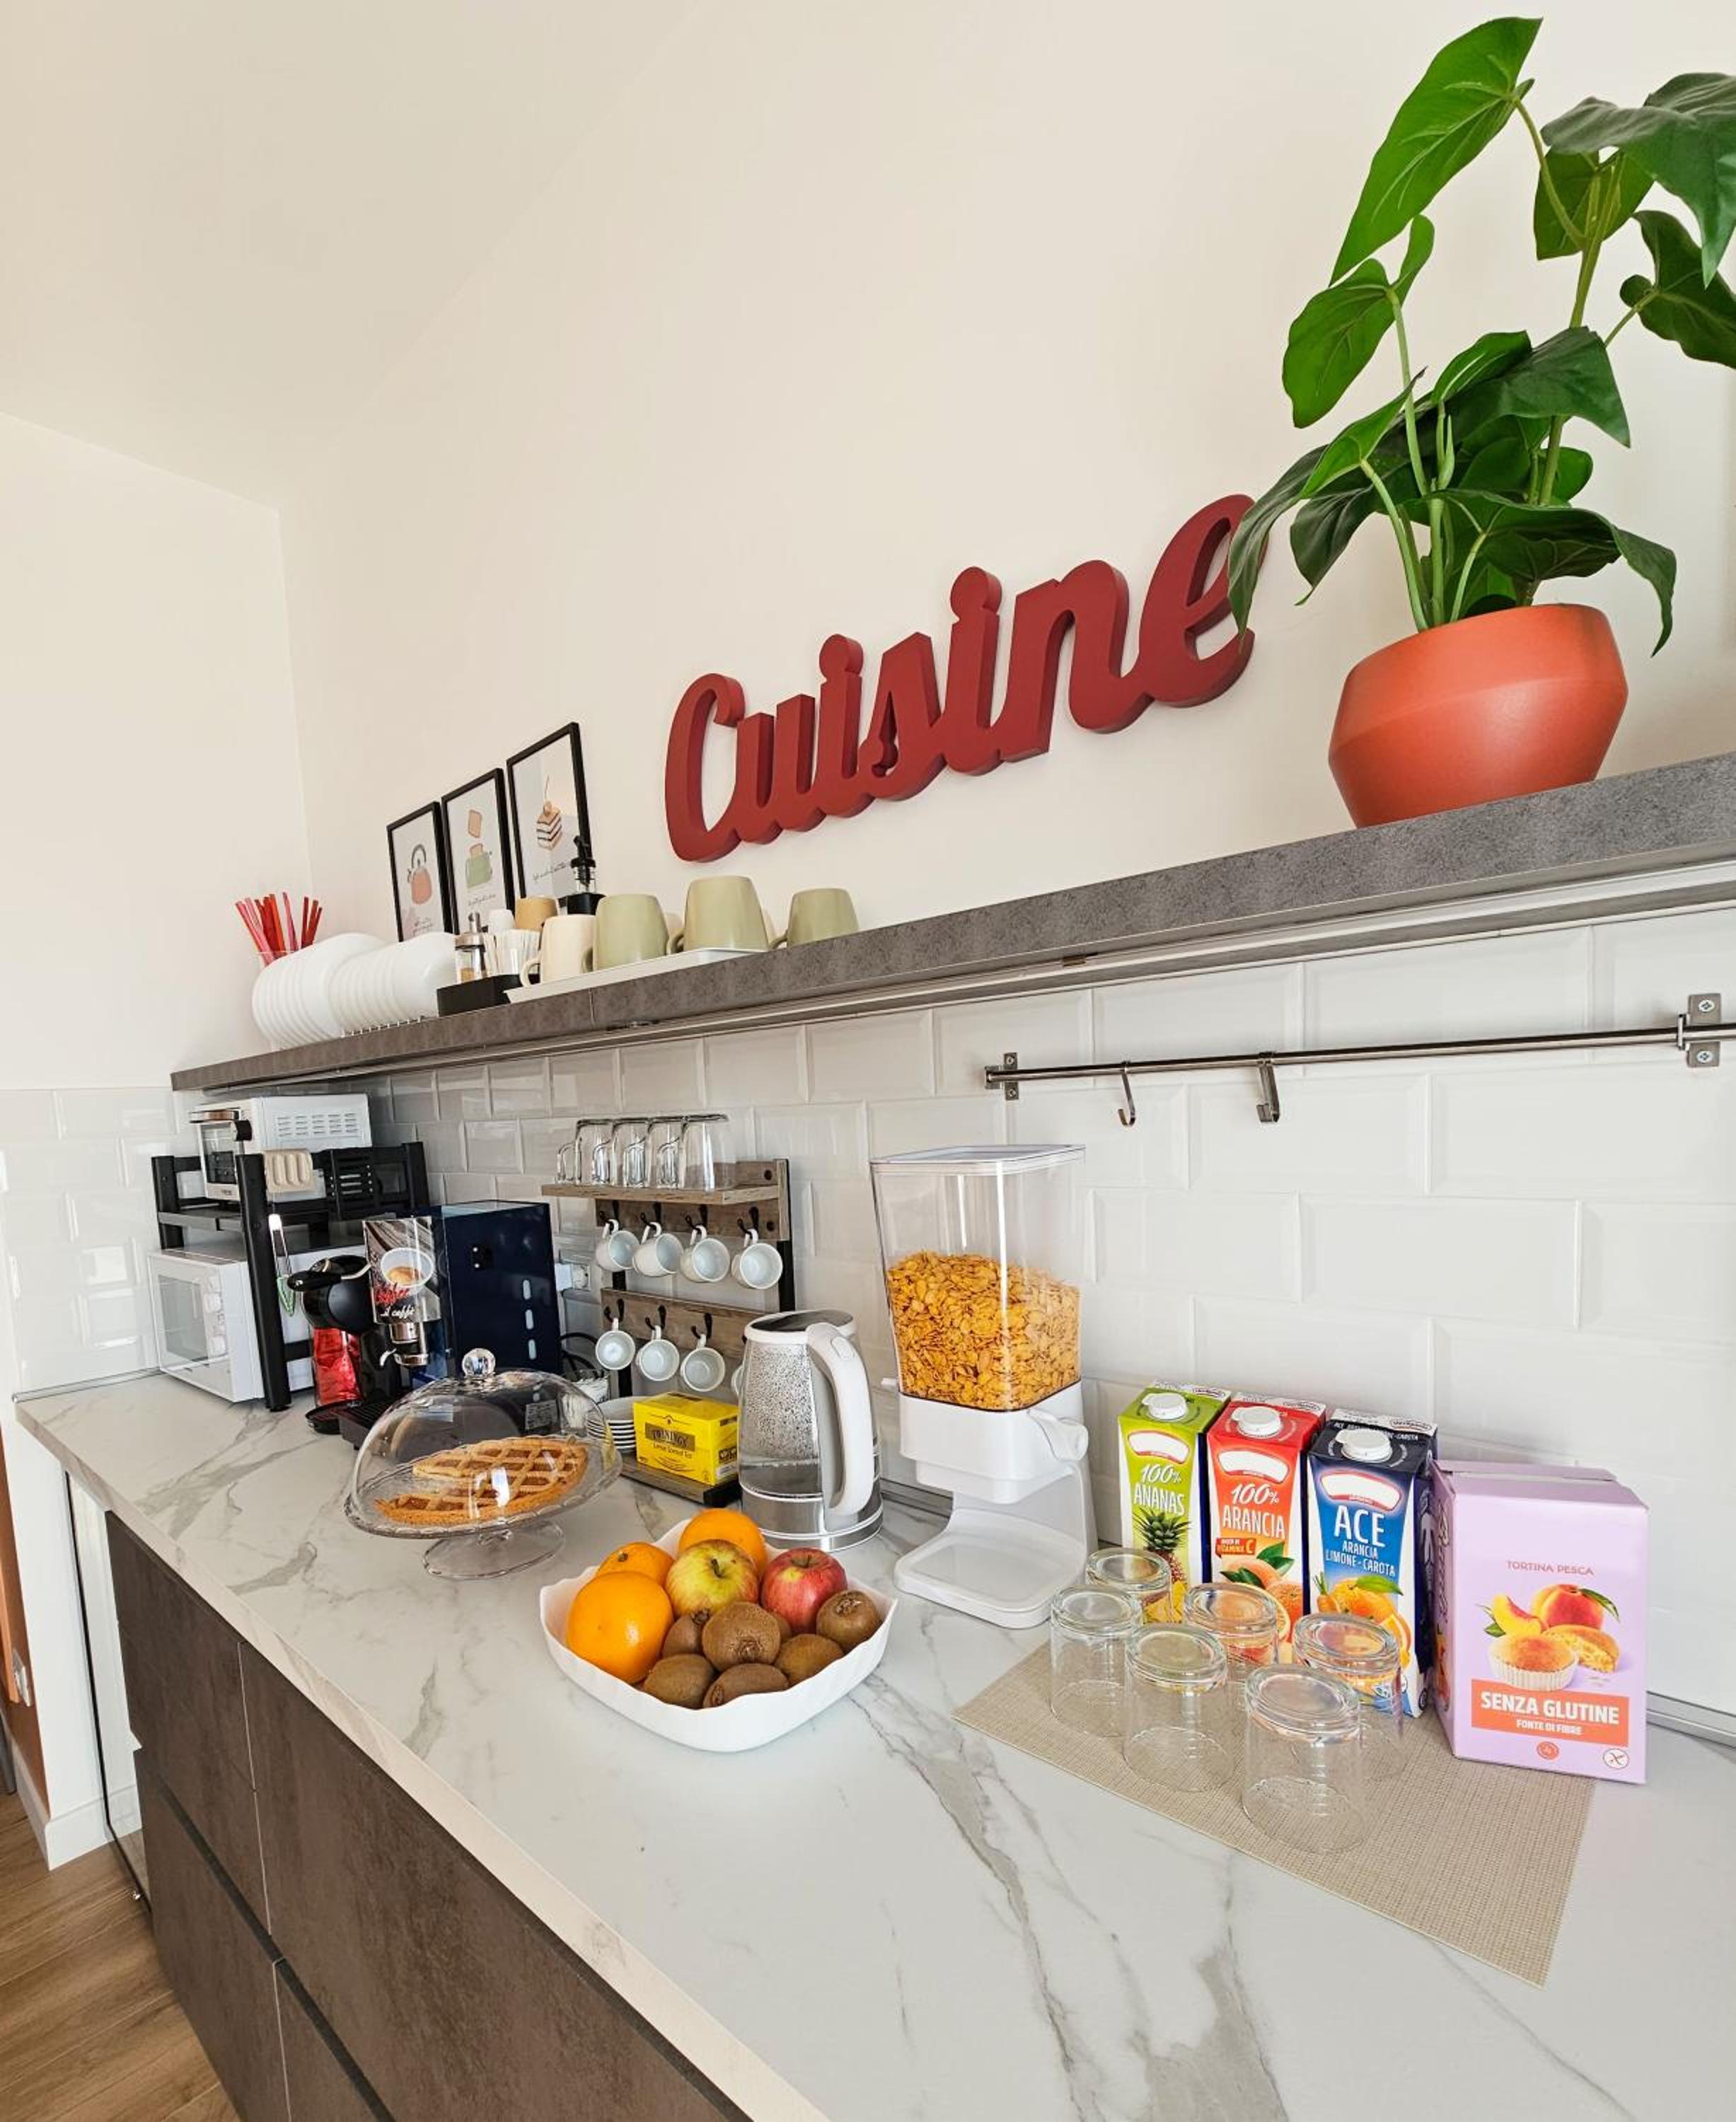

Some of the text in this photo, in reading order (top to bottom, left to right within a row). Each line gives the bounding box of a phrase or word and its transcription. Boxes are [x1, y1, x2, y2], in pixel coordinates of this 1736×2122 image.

[664, 494, 1269, 863] Cuisine
[1142, 1463, 1182, 1483] 100%
[1133, 1482, 1185, 1517] ANANAS
[1232, 1483, 1279, 1504] 100%
[1222, 1504, 1285, 1540] ARANCIA
[1333, 1504, 1385, 1548] ACE
[1342, 1540, 1378, 1560] ARANCIA
[1506, 1560, 1595, 1576] TORTINA PESCA
[1481, 1691, 1619, 1724] SENZA GLUTINE
[1516, 1719, 1544, 1731] FONTE
[1545, 1724, 1556, 1732] DI
